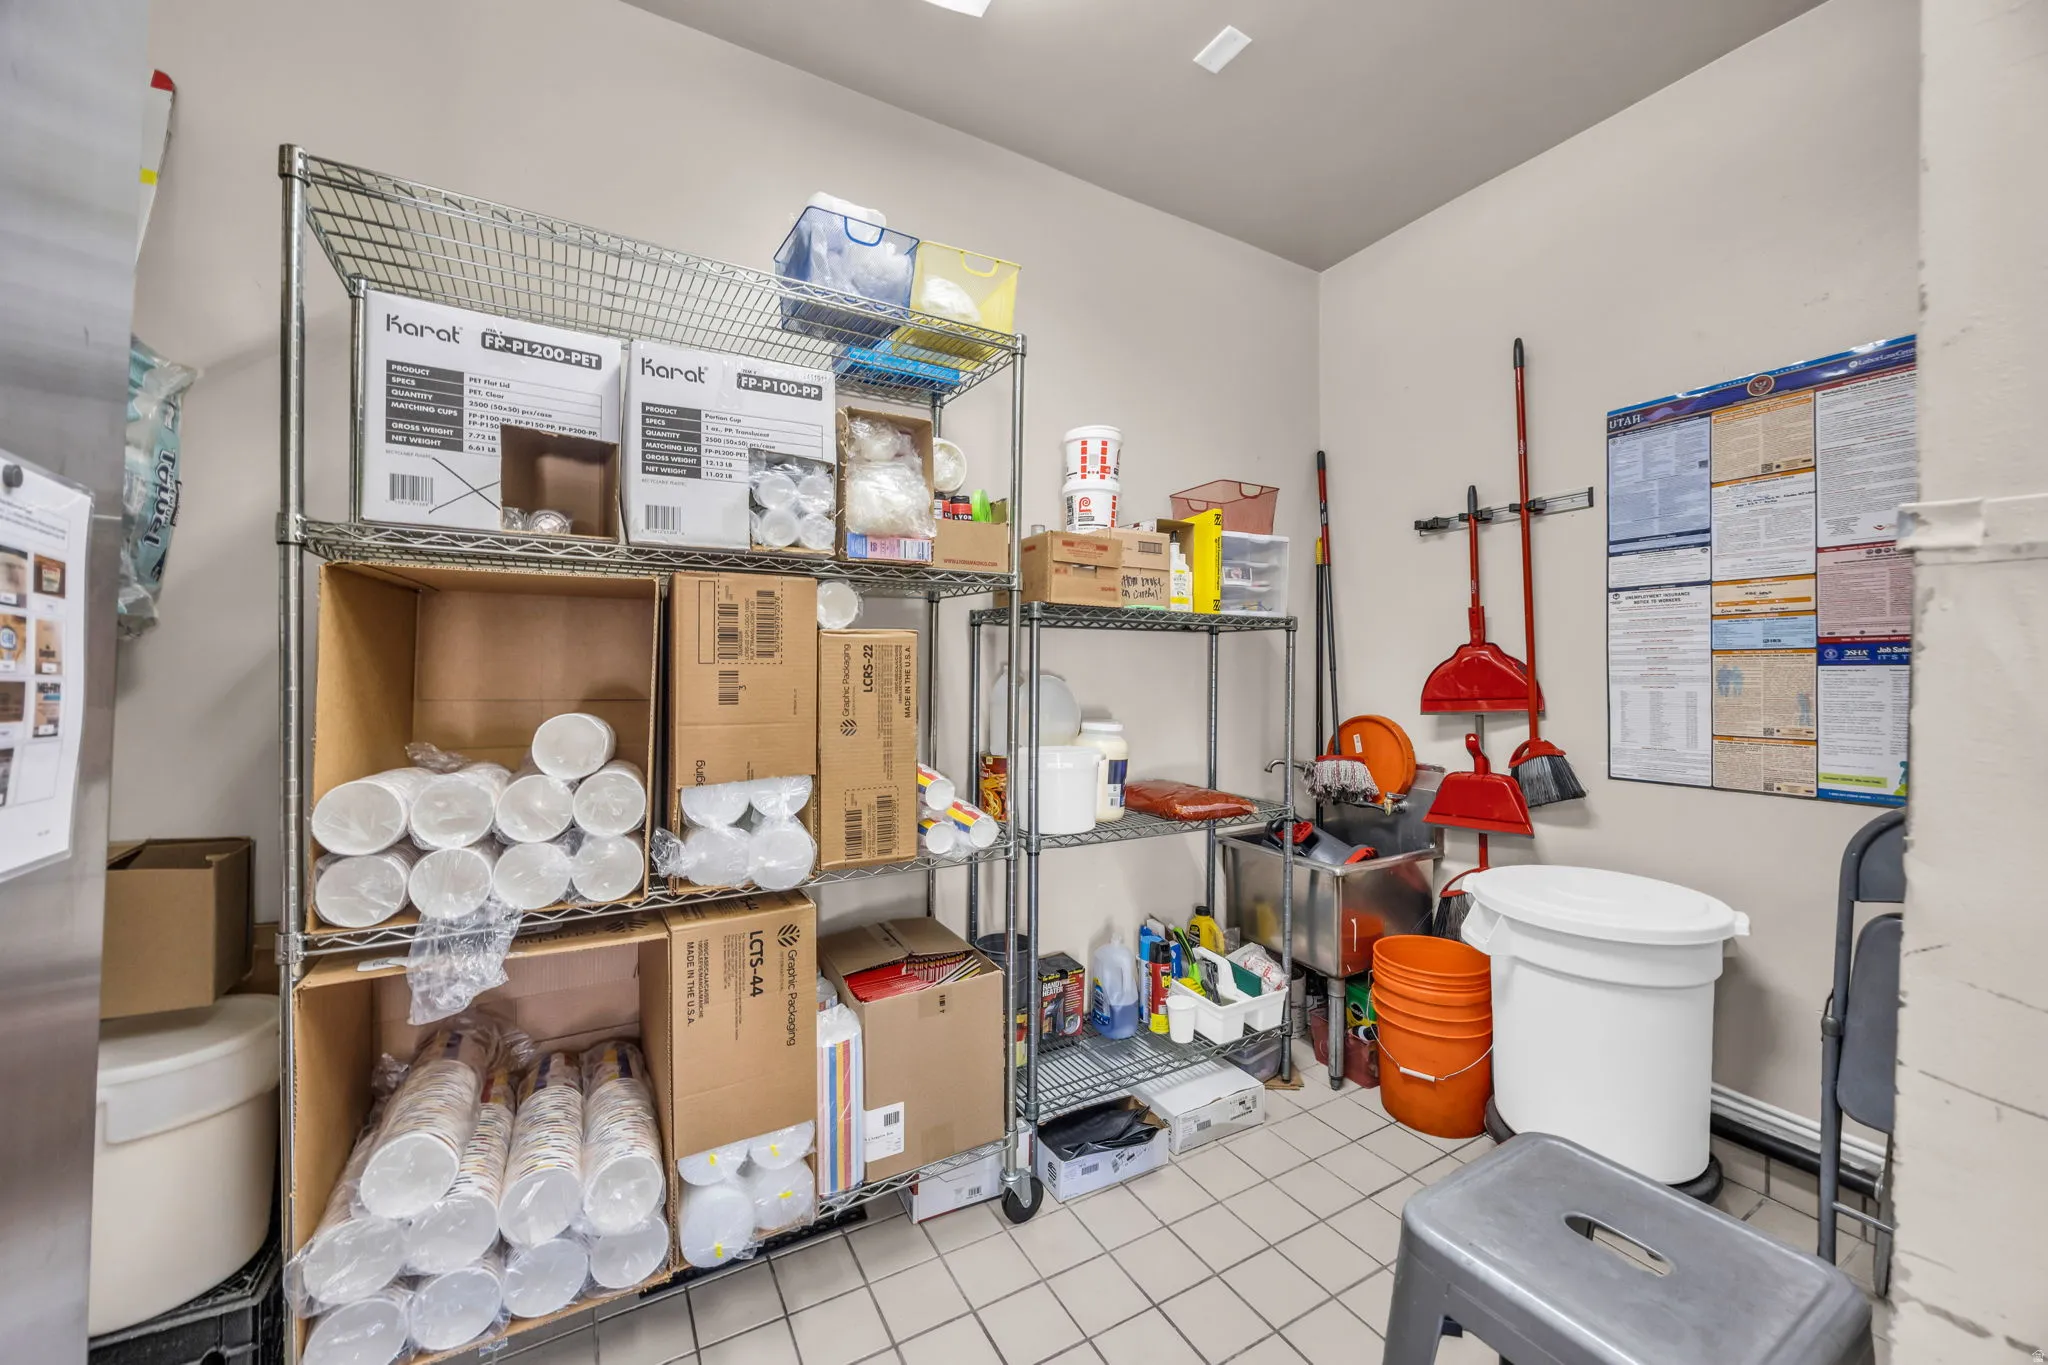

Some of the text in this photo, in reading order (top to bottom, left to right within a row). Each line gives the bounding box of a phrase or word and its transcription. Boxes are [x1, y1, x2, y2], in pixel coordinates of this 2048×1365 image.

[386, 313, 460, 344] Karat
[484, 334, 599, 369] FP-PL200-PET
[391, 364, 430, 376] PRODUCT
[641, 357, 705, 384] Karat
[391, 376, 416, 386] SPECS
[468, 376, 511, 389] PET Flat Lid
[468, 388, 484, 398] PET,
[740, 376, 820, 399] FP-P100-PP
[391, 388, 433, 401] QUANTITY
[391, 401, 458, 417] MATCHING CUPS
[468, 402, 489, 410] 2500
[490, 402, 520, 414] (50x50)
[645, 406, 678, 416] PRODUCT
[645, 418, 666, 427] SPECS
[704, 413, 728, 422] Portion
[1609, 414, 1641, 430] UTAH
[391, 422, 454, 436] GROSS WEIGHT
[645, 430, 680, 440] QUANTITY
[391, 434, 441, 447] NET WEIGHT
[468, 432, 496, 442] 7.72 LB
[705, 436, 722, 444] 2500
[468, 444, 486, 452] 6.61
[645, 442, 698, 453] MATCHING LIDS
[645, 453, 697, 465] GROSS WEIGHT
[705, 458, 724, 467] 12.13
[660, 466, 687, 476] WEIGHT
[705, 470, 732, 480] 11.02 LB
[143, 449, 176, 547] Towel
[1877, 646, 1892, 654] Job
[863, 644, 873, 693] LCRS-22
[842, 644, 852, 716] Graphic Packaging
[904, 686, 910, 694] IN
[750, 930, 764, 998] LCTS-44
[686, 942, 695, 1027] MADE IN THE U.S.A.
[1042, 981, 1063, 990] HANDY
[786, 949, 798, 1047] Graphic Packaging
[1042, 986, 1064, 998] HEATER
